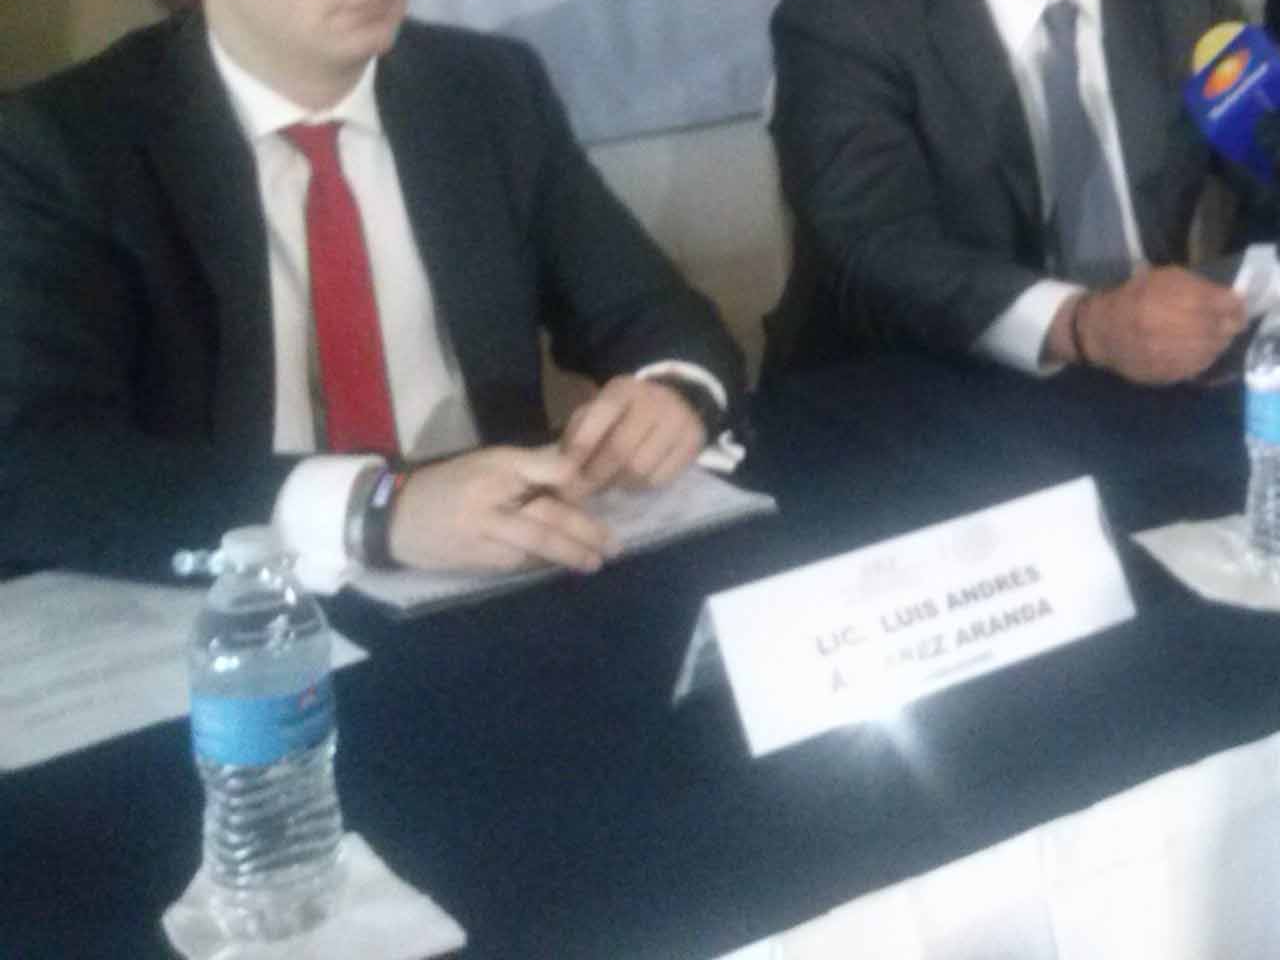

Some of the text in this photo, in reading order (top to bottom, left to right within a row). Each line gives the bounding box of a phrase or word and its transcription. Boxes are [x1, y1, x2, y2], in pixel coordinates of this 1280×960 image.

[815, 625, 870, 656] LIC.
[880, 601, 940, 635] LUIS
[946, 562, 1041, 612] ANDRÉS
[955, 597, 1053, 648] ARANDA
